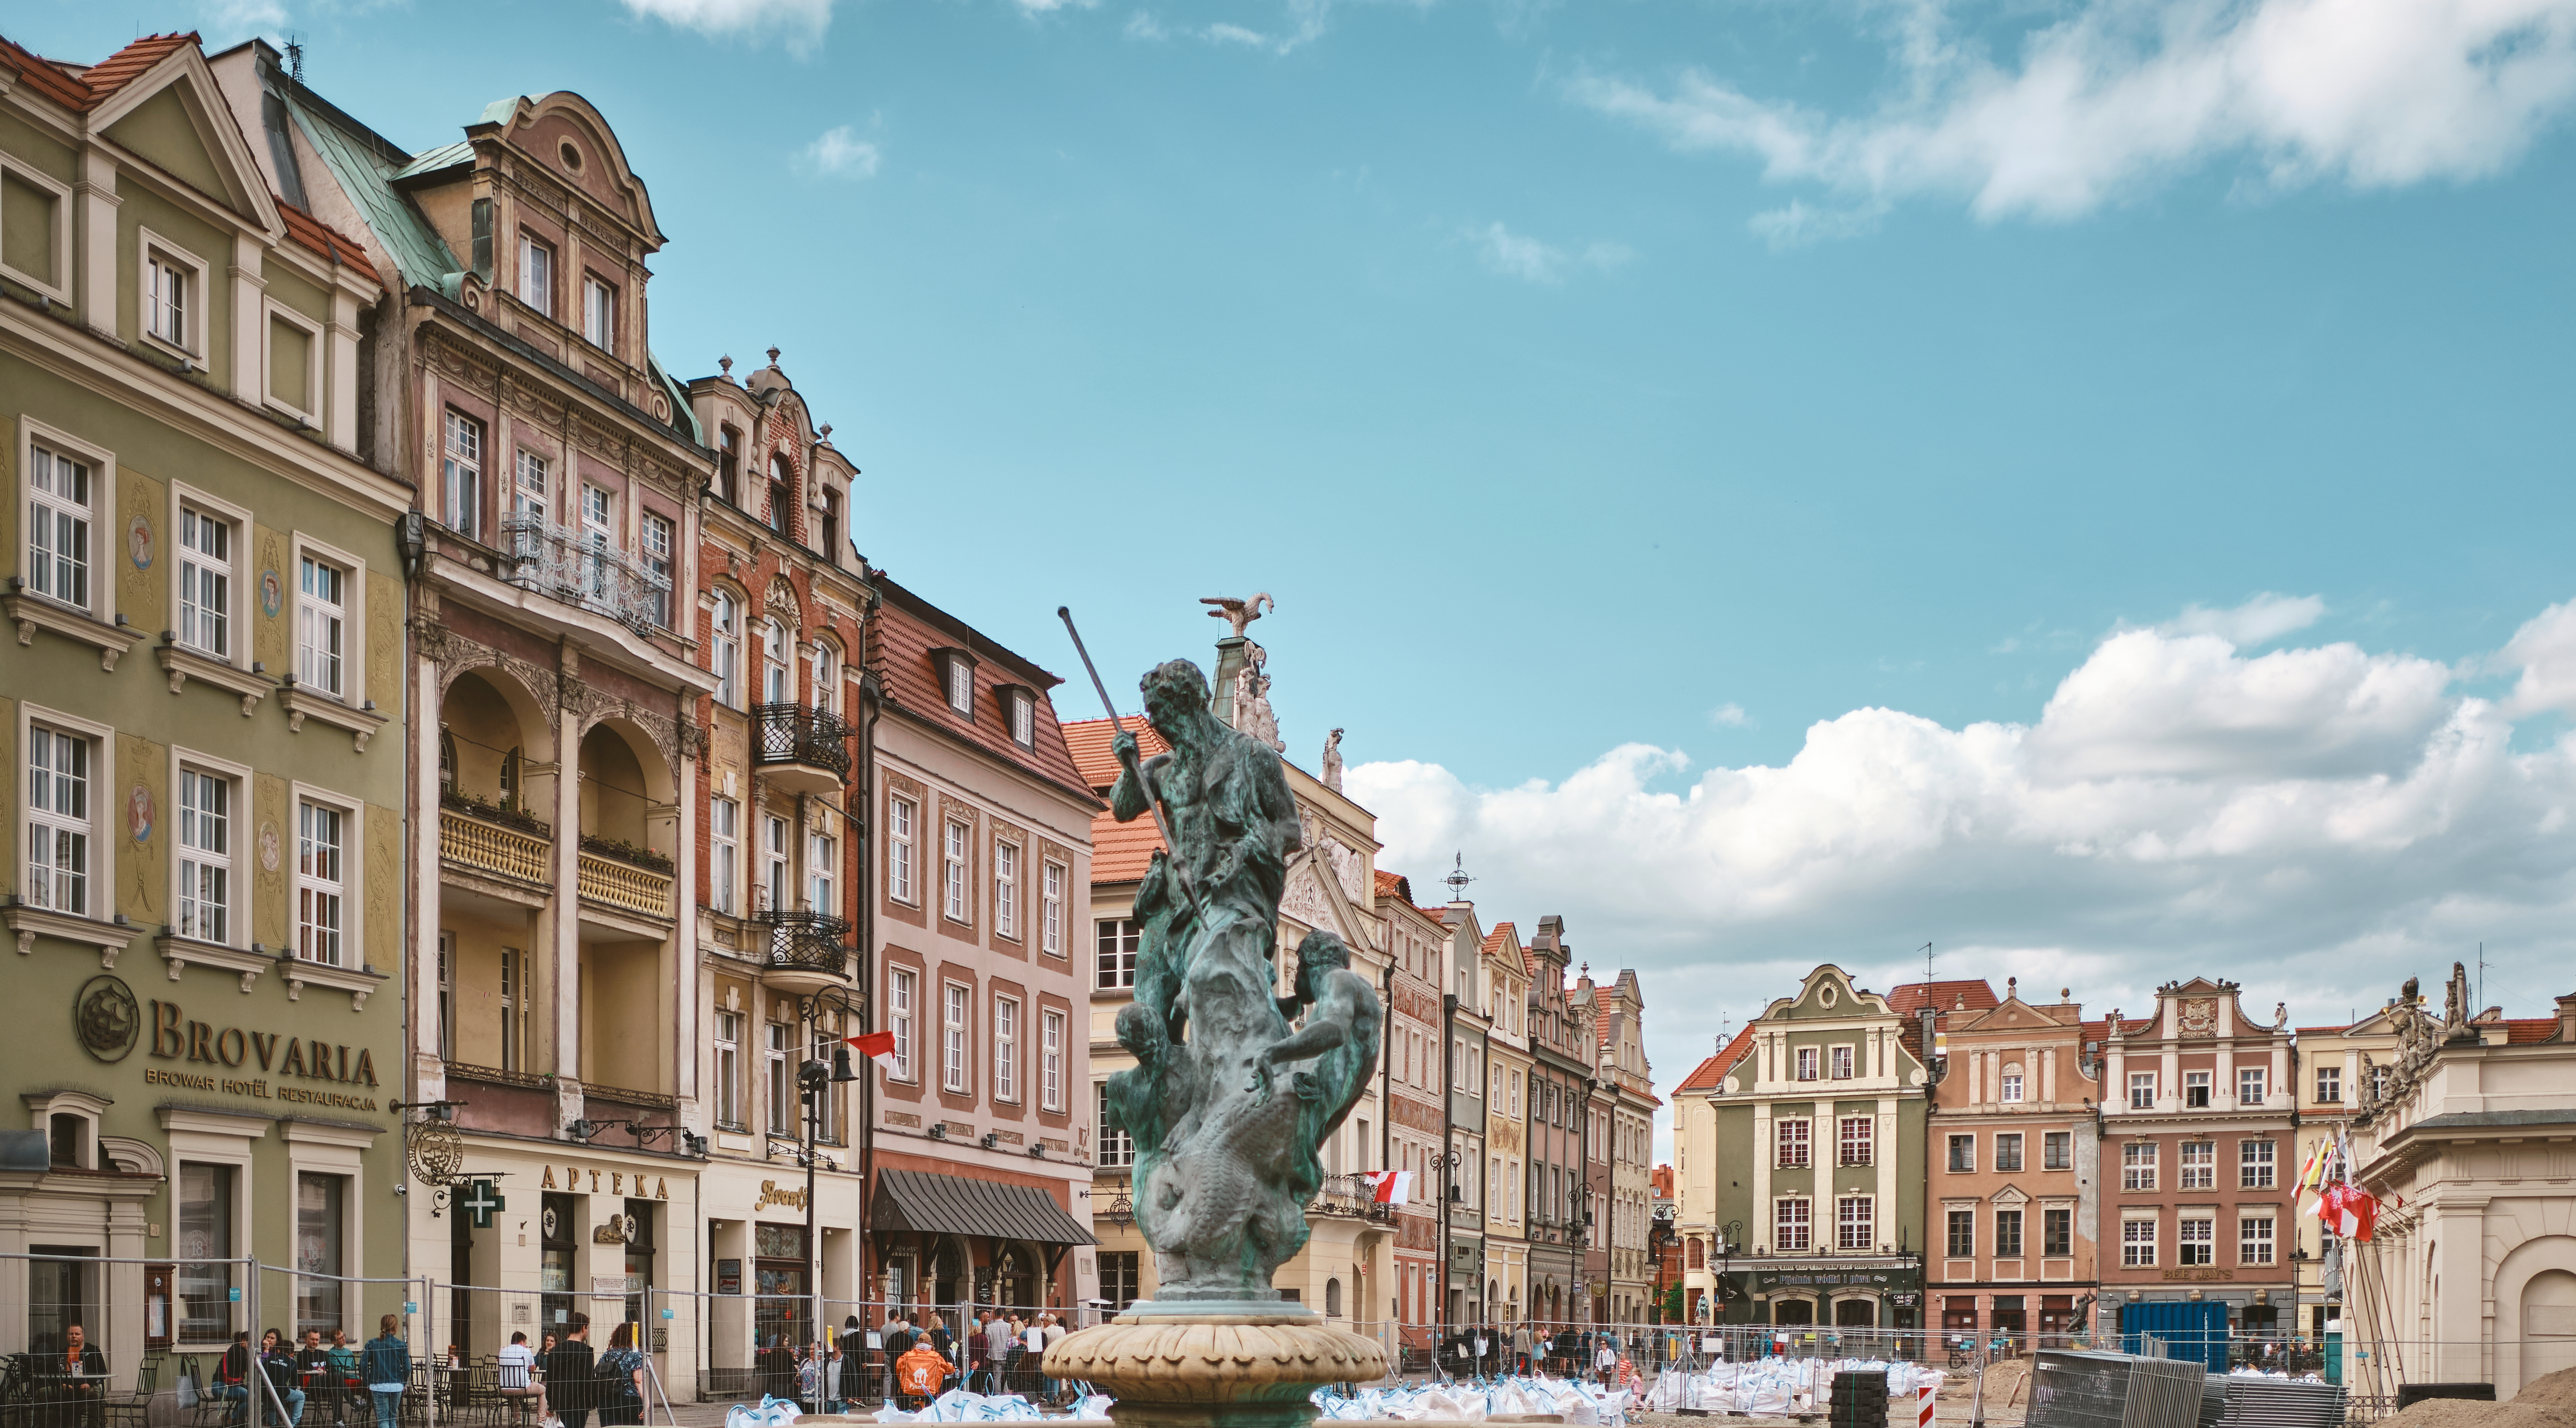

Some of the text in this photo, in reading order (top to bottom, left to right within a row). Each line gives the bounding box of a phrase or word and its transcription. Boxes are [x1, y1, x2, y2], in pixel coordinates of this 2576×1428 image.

[150, 998, 380, 1086] BROVARIA
[146, 1068, 377, 1111] BROWAR HOTEL RESTAURACJA
[541, 1165, 669, 1199] APTEKA
[191, 1240, 204, 1256] 18
[748, 1257, 753, 1265] 76
[1779, 1274, 1870, 1285] Pijalnia wódki i piwa
[2162, 1269, 2233, 1280] BEE JAY'S
